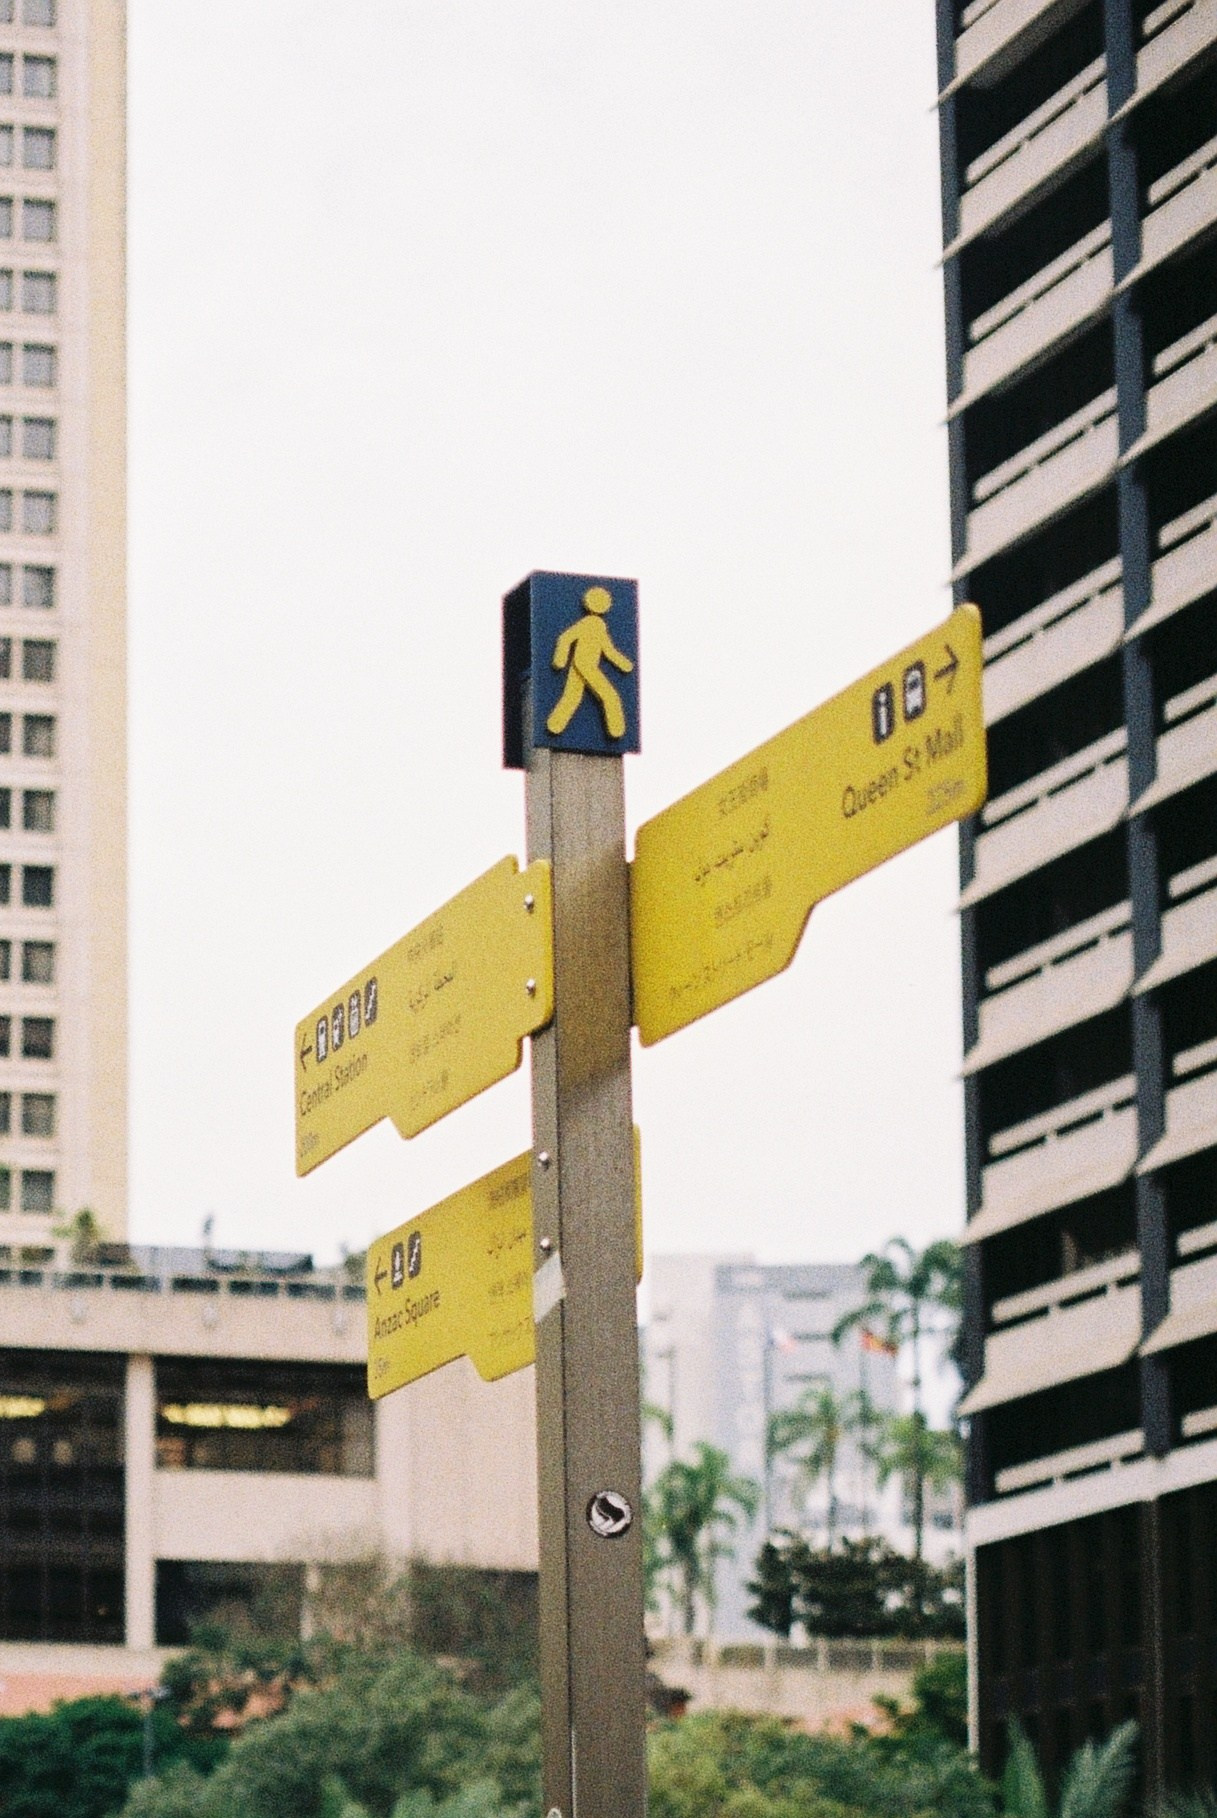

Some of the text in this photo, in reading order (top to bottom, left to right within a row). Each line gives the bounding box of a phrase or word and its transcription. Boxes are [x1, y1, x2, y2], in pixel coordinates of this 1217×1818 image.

[842, 767, 899, 818] Queen
[903, 746, 921, 780] St
[925, 712, 964, 766] Mall
[299, 1068, 333, 1116] Central
[334, 1054, 368, 1091] Station
[374, 1290, 440, 1339] Anzac Square
